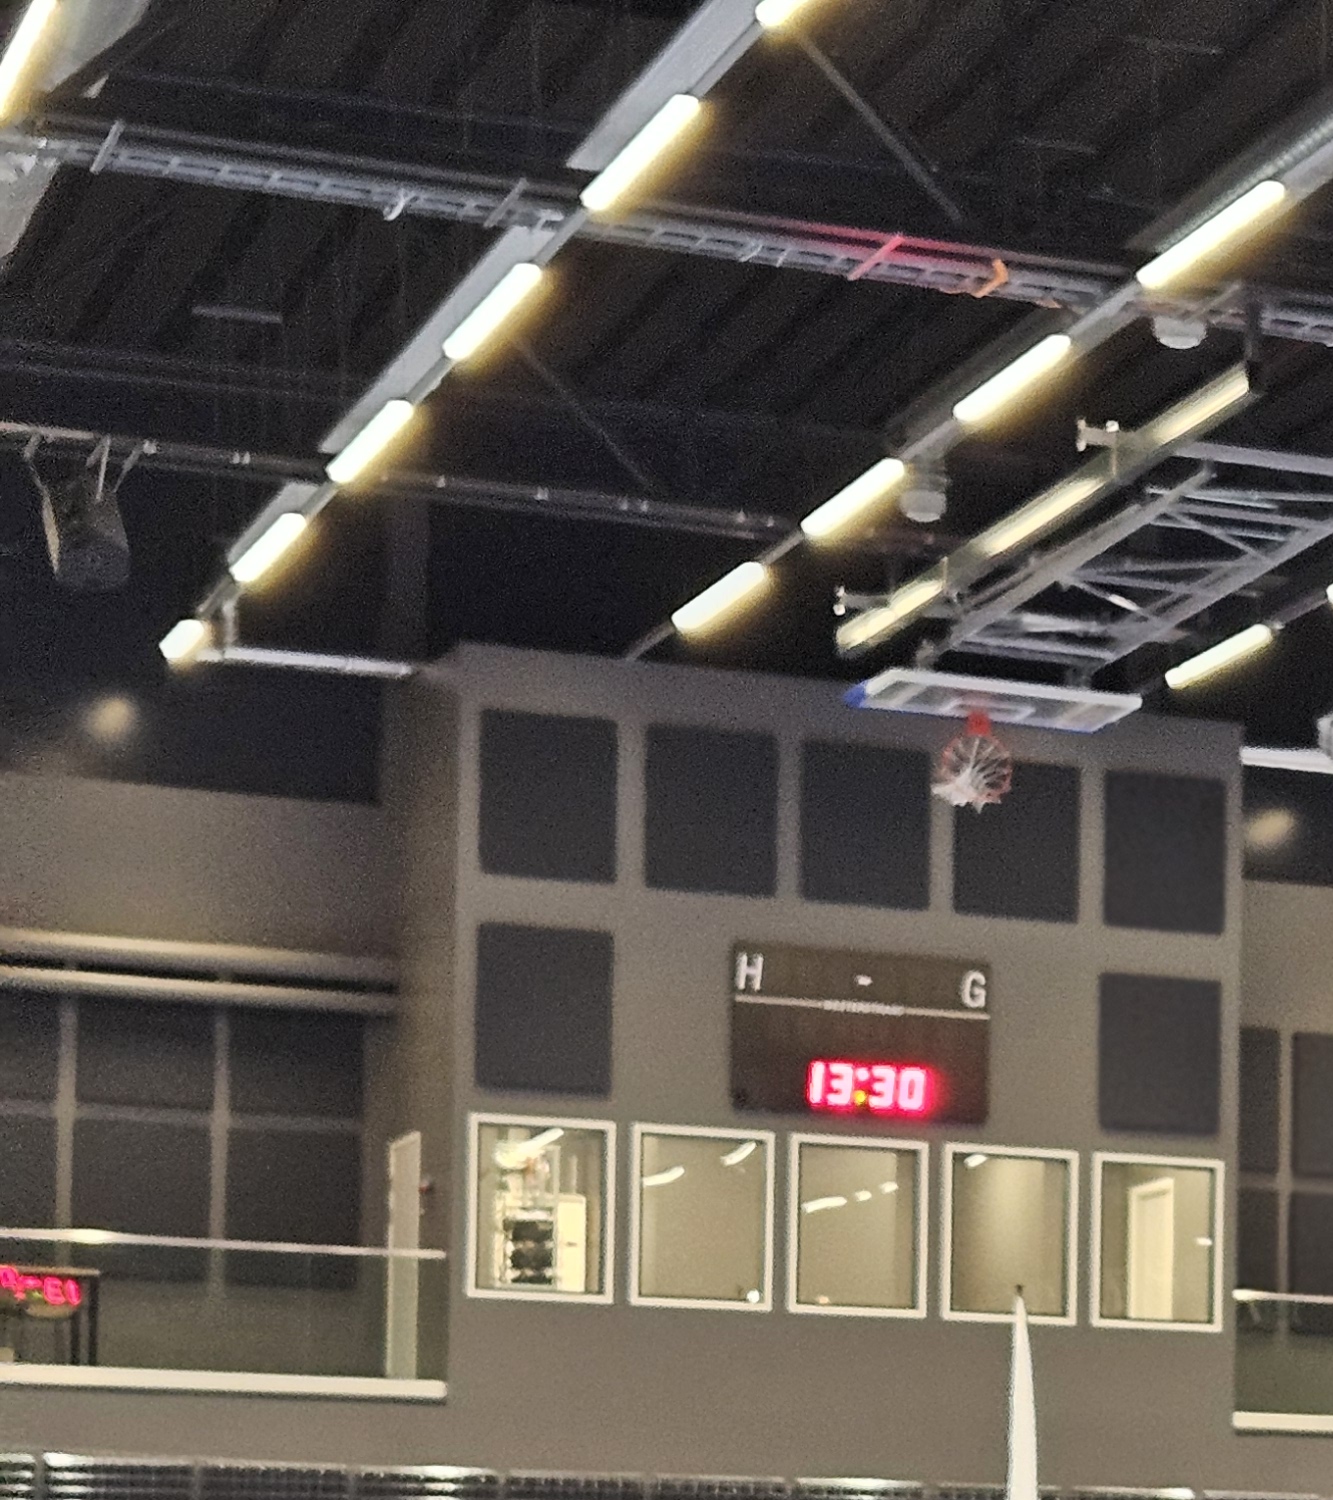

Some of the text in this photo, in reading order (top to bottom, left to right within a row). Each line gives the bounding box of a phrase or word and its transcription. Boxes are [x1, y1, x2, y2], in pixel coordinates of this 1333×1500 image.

[735, 952, 988, 1009] H G
[807, 1059, 929, 1113] 13:30
